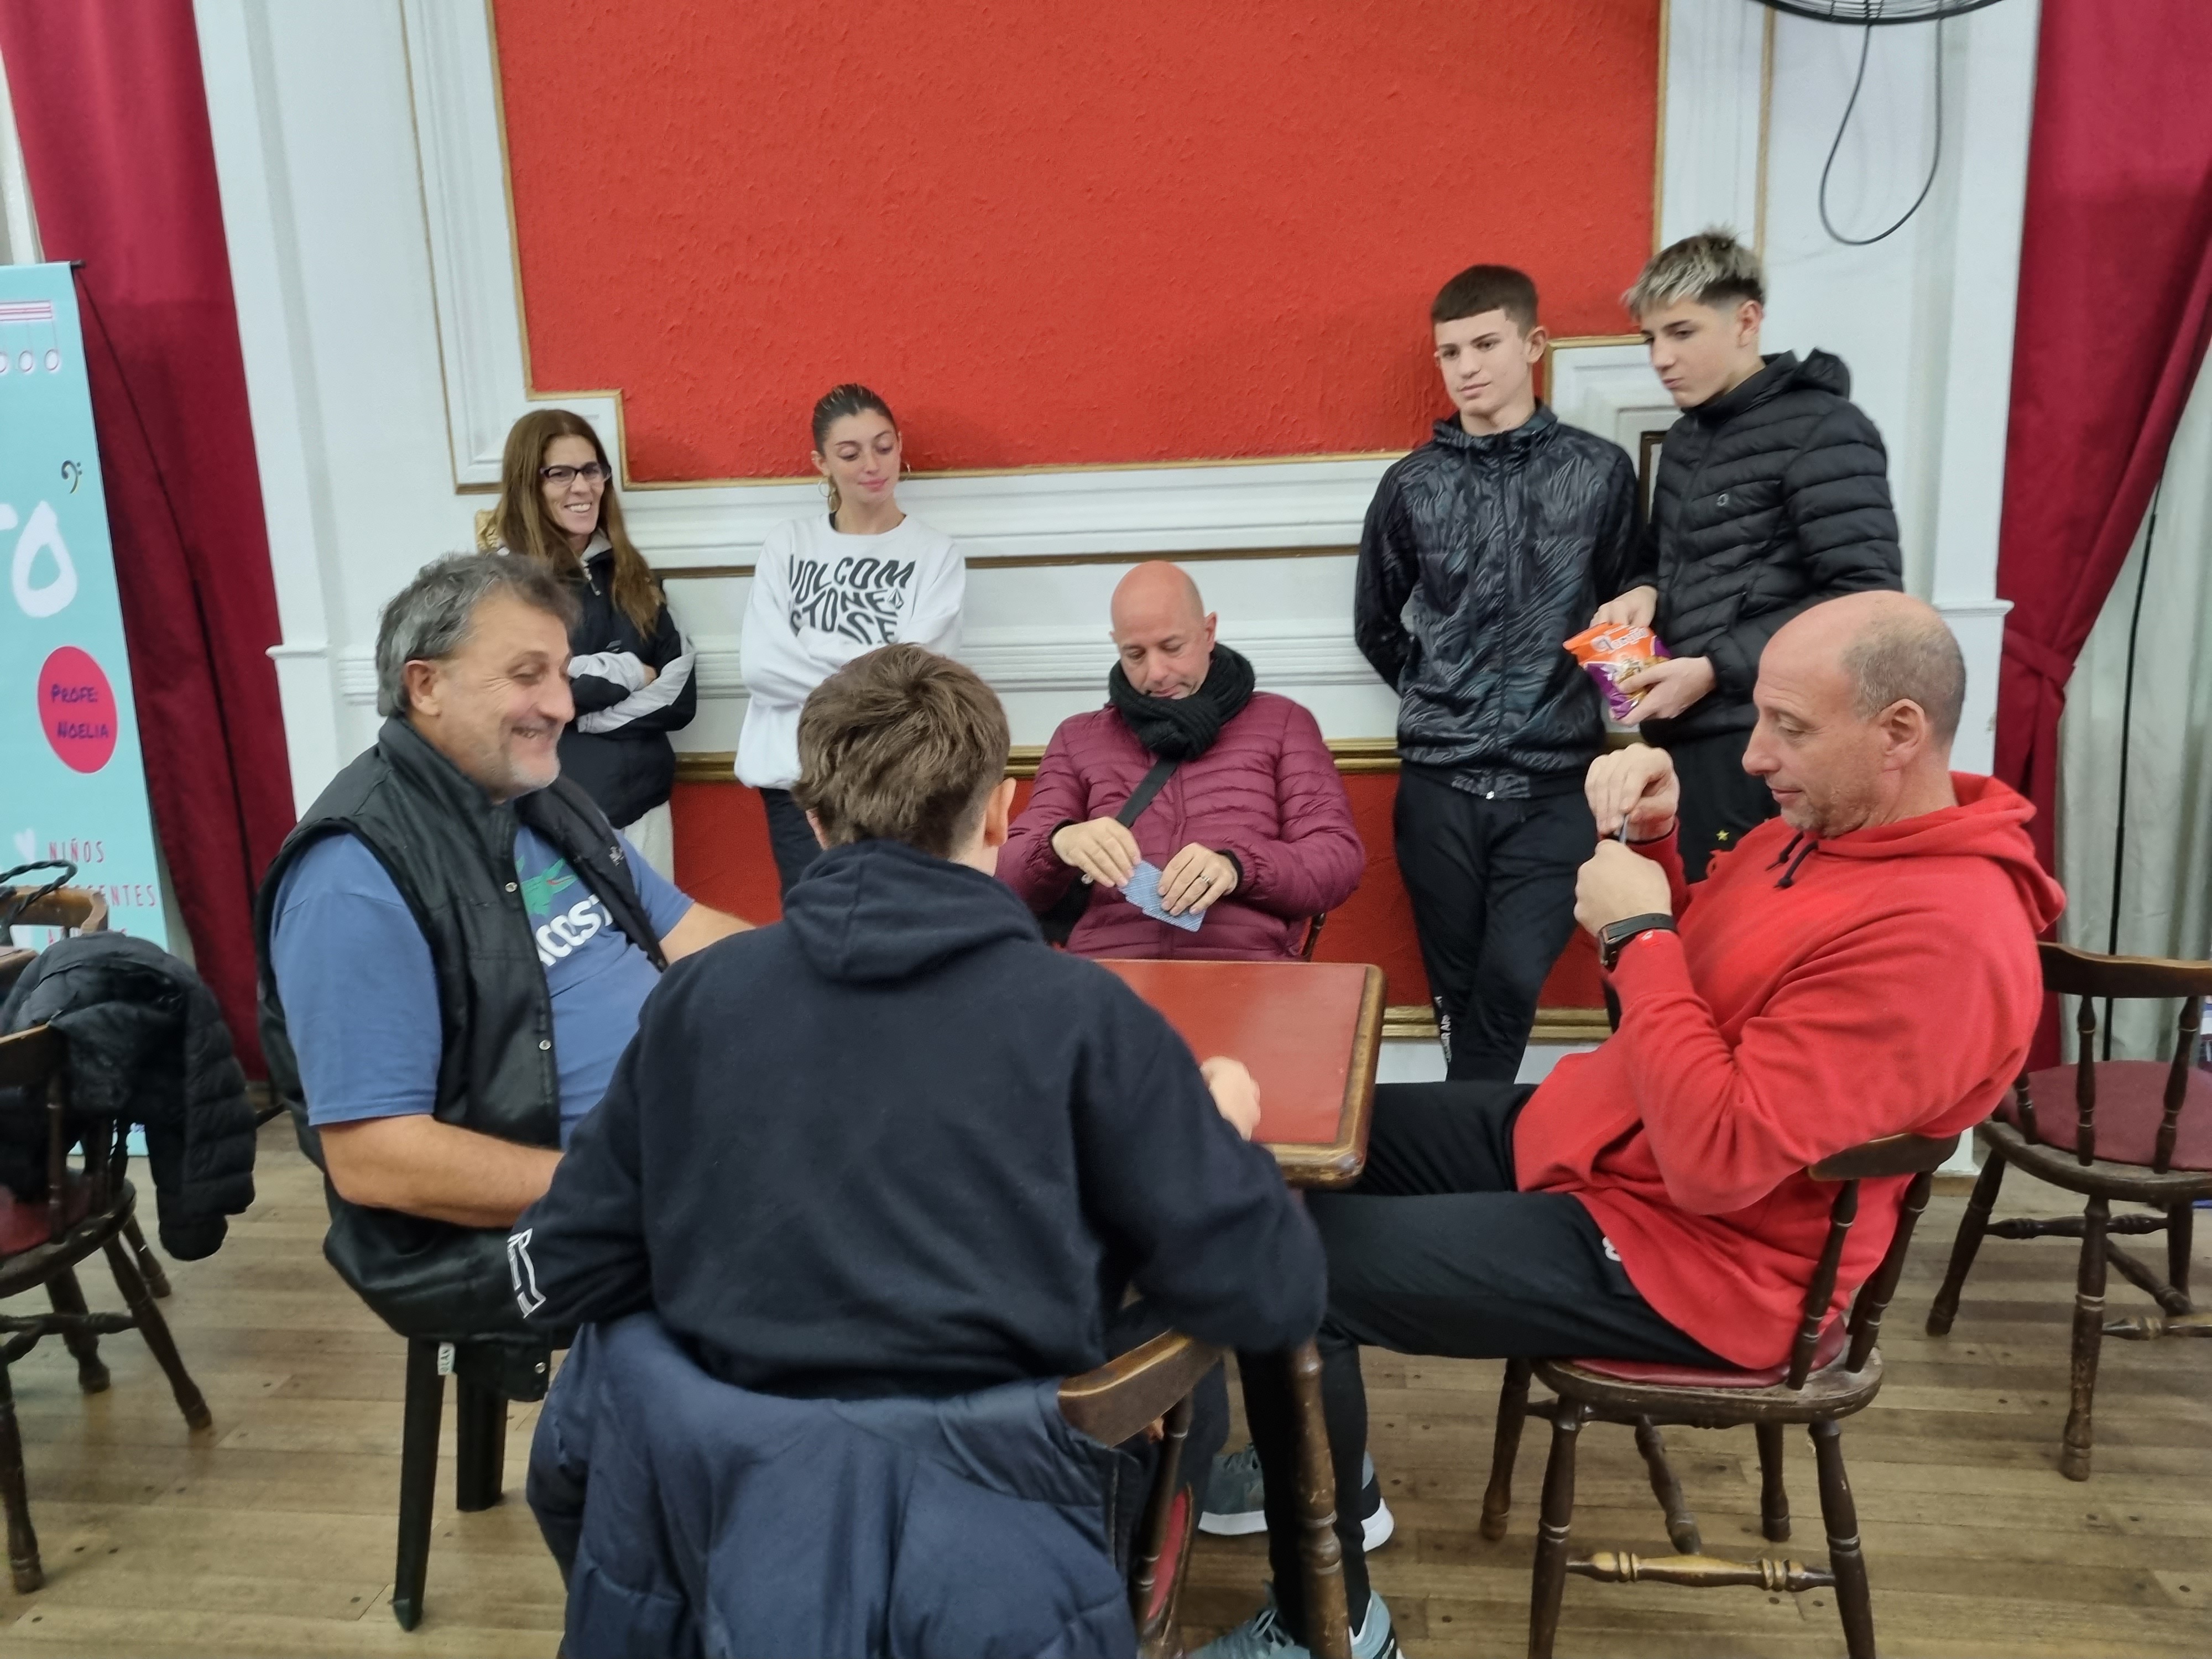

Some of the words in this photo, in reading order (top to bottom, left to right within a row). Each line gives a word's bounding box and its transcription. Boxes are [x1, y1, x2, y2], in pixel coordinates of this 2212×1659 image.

[790, 554, 916, 604] VOLCOM
[58, 721, 109, 739] NOELIA
[49, 837, 105, 863] NIÑOS
